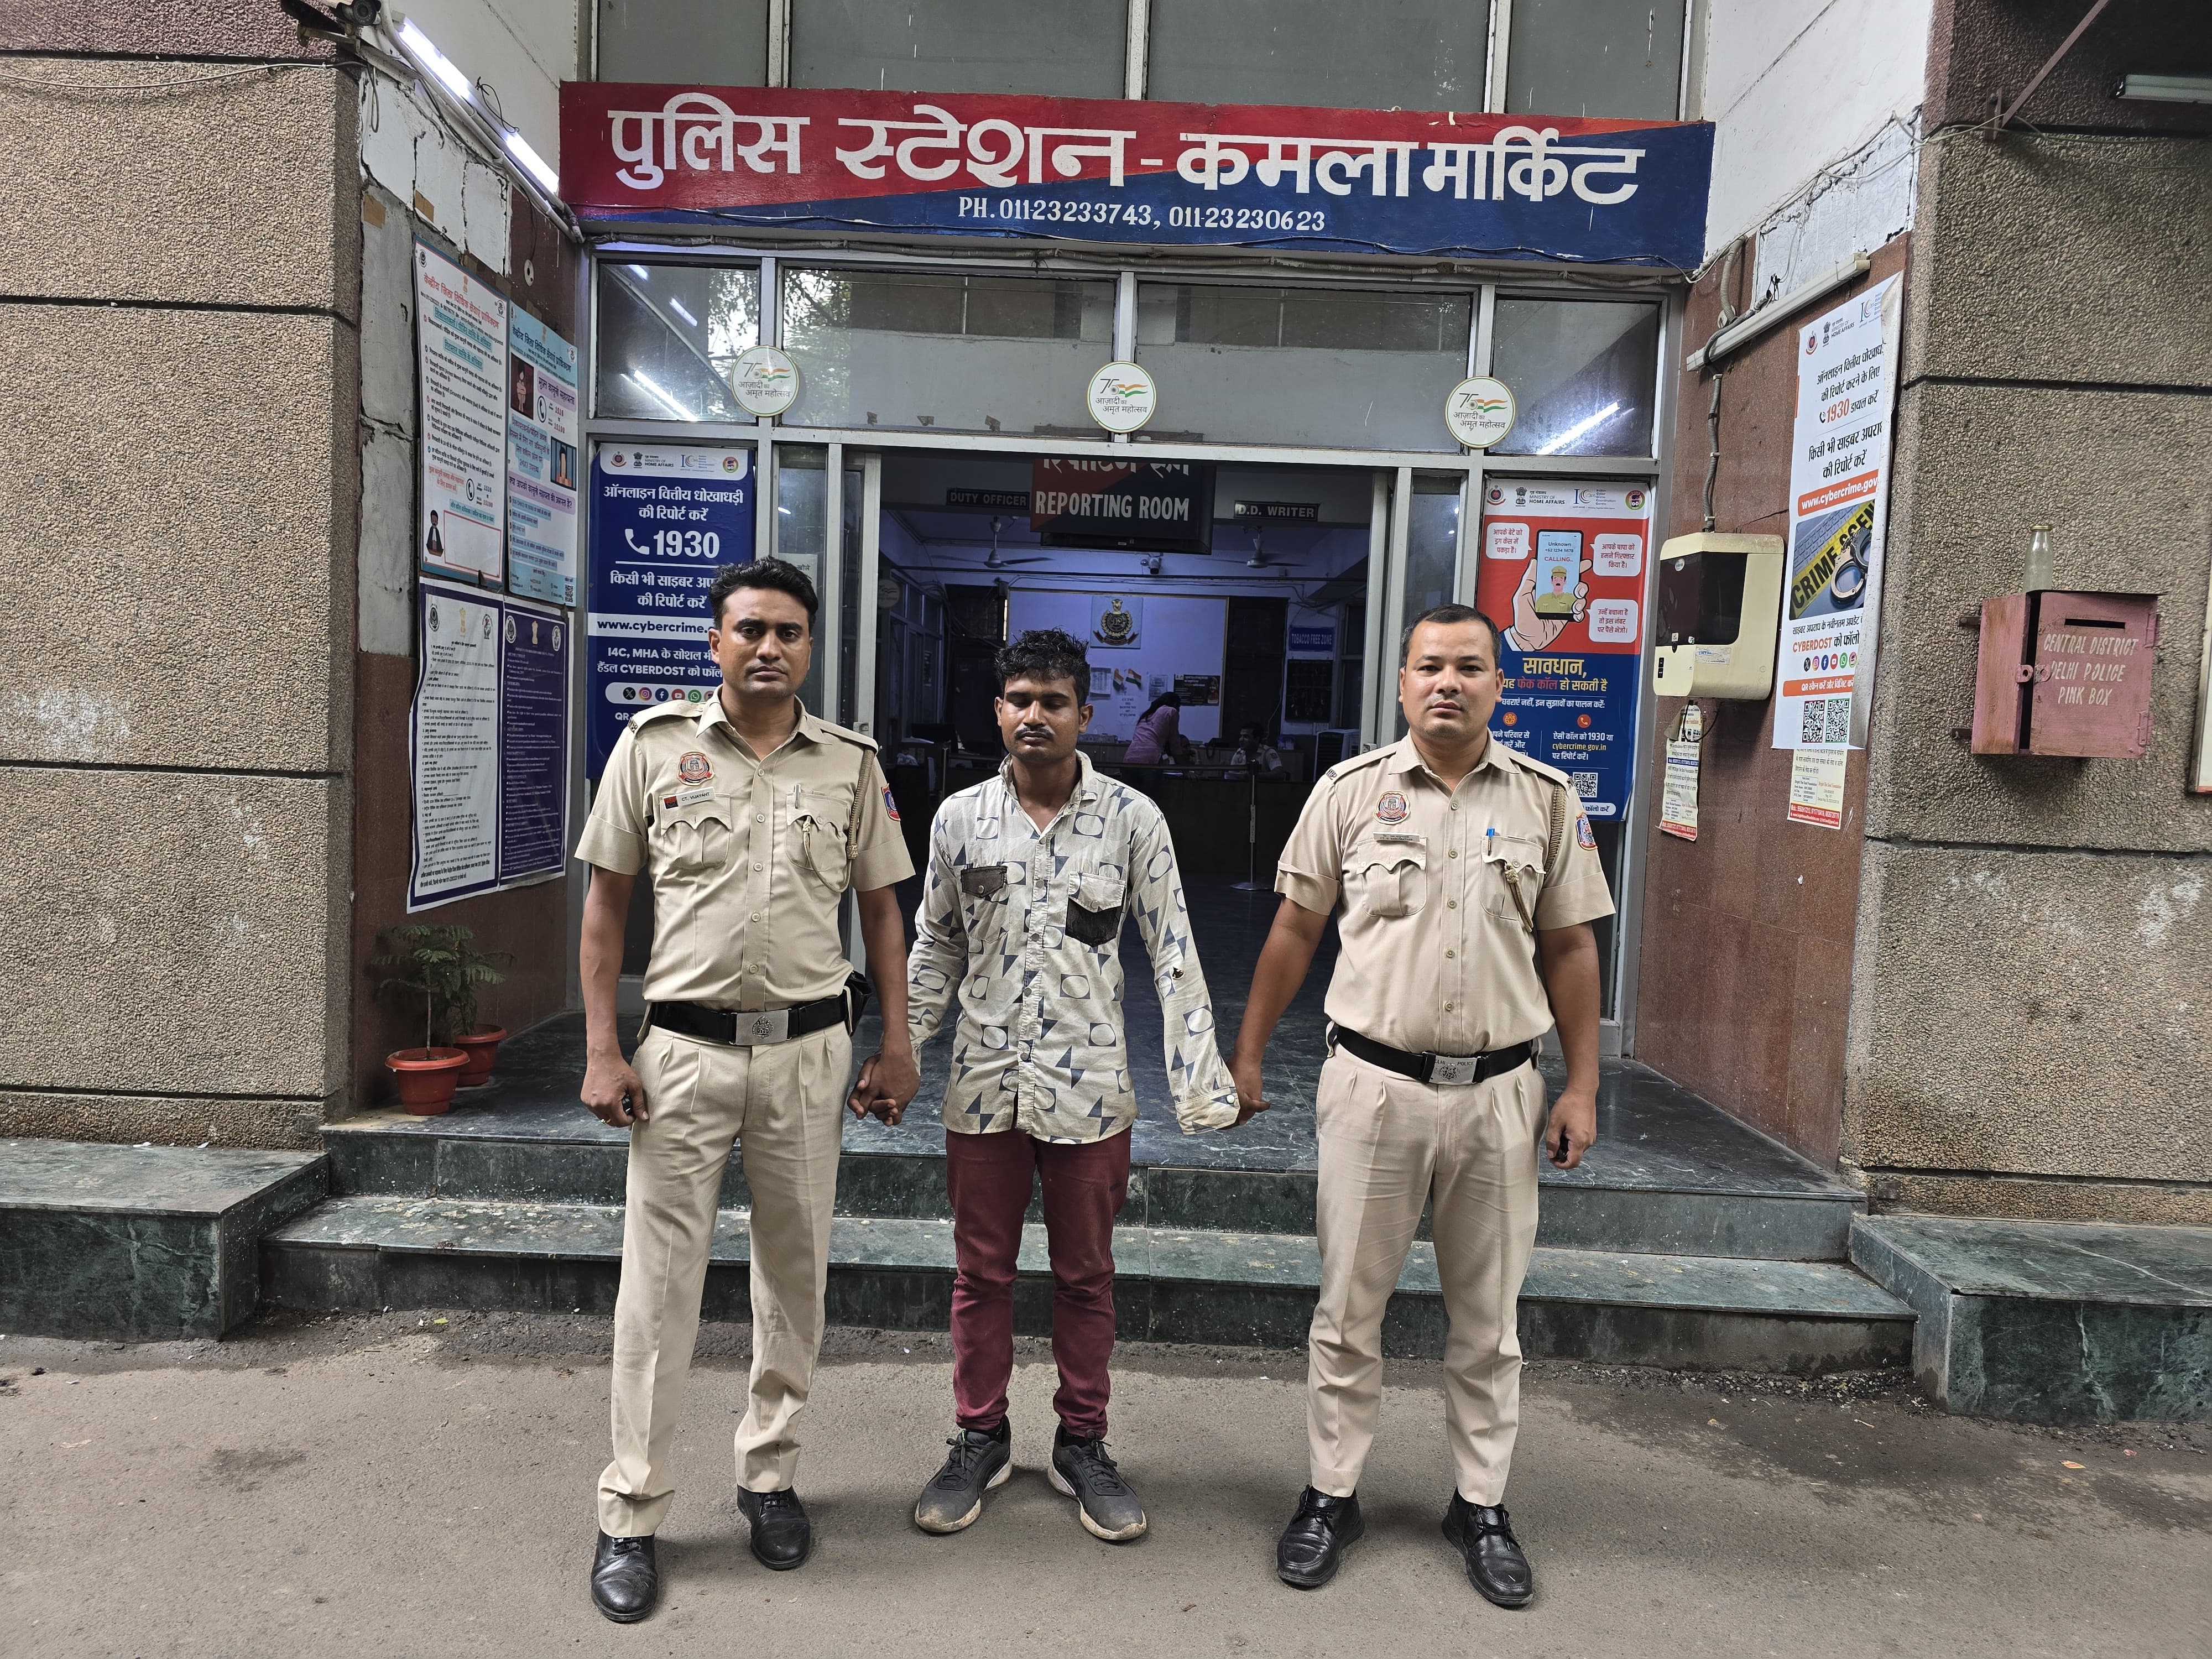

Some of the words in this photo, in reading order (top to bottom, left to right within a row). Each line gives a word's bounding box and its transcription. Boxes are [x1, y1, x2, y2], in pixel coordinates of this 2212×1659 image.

[607, 92, 810, 190] पुलिस
[836, 105, 1136, 188] स्टेशन
[1176, 132, 1418, 197] कमला
[1423, 126, 1646, 205] मार्किट
[958, 196, 995, 218] PH.
[1170, 206, 1326, 231] 011-23230623
[1831, 329, 1841, 338] HOME
[1817, 364, 1843, 385] ऑनलाइन
[1844, 354, 1861, 372] वित्तीय
[745, 390, 763, 399] अमृत
[765, 388, 792, 398] महोत्सव
[1821, 388, 1829, 405] की
[1830, 379, 1845, 399] रिपोर्ट
[1846, 373, 1860, 390] करने
[1861, 371, 1868, 383] के
[1869, 366, 1880, 380] लिए
[1103, 405, 1120, 415] अमृत
[1121, 404, 1147, 414] महोत्सव
[1827, 398, 1850, 423] 1930
[1850, 397, 1866, 413] डायल
[1867, 389, 1879, 405] करें
[1460, 420, 1478, 430] अमृत
[1479, 419, 1506, 429] महोत्सव
[1808, 441, 1825, 462] किसी
[1827, 437, 1835, 453] भी
[1837, 431, 1860, 450] साइबर
[1823, 461, 1833, 478] की
[1834, 453, 1853, 476] रिपोर्ट
[1854, 449, 1867, 468] करें
[603, 484, 656, 500] ऑनलाइन
[658, 486, 691, 501] वित्तीय
[694, 488, 743, 505] धोखाधड़ी
[951, 492, 978, 503] DUTY
[983, 494, 1027, 507] OFFICER
[639, 504, 654, 519] की
[656, 505, 686, 520] रिपोर्ट
[688, 508, 709, 521] करें
[1035, 491, 1133, 518] REPORTING
[1138, 495, 1190, 521] ROOM
[1267, 506, 1314, 518] WRITER
[653, 530, 719, 559] 1930
[610, 570, 639, 585] किसी
[641, 571, 655, 586] भी
[657, 576, 693, 588] साइबर
[1791, 544, 1838, 609] CRIME
[637, 592, 653, 607] की
[655, 592, 685, 608] रिपोर्ट
[687, 595, 707, 608] करें
[1792, 625, 1806, 635] साइबर
[1807, 623, 1821, 633] अपराध
[1821, 620, 1826, 630] के
[1827, 618, 1845, 630] नवीनतम
[1845, 614, 1860, 627] अपडेट
[1291, 633, 1310, 645] TOBACCO
[1310, 634, 1321, 645] FREE
[1321, 634, 1332, 645] ZONE
[1792, 637, 1833, 653] CYBERDOST
[1834, 633, 1843, 647] को
[1843, 629, 1860, 646] फॉलो
[2043, 633, 2086, 655] CENTRAL
[2089, 636, 2140, 658] DISTRICT
[633, 648, 659, 659] MHA
[661, 647, 671, 659] के
[672, 648, 701, 661] सोशल
[597, 661, 618, 673] हैंडल
[620, 664, 685, 676] CYBERDOST
[687, 665, 700, 677] को
[1522, 657, 1588, 679] सावधान,
[2052, 660, 2079, 680] DELHI
[2083, 662, 2126, 682] POLICE
[1503, 679, 1516, 688] यह
[1517, 678, 1535, 689] फेक
[1537, 677, 1558, 690] कॉल
[1559, 677, 1571, 691] हो
[1571, 678, 1599, 691] सकती
[1600, 678, 1608, 692] है
[1801, 683, 1809, 691] QR
[1826, 679, 1834, 689] और
[1546, 698, 1566, 709] सुझावों
[2058, 686, 2085, 706] PINK
[2088, 687, 2114, 706] BOX
[1504, 730, 1523, 738] परिवार
[1524, 730, 1530, 739] से
[1553, 731, 1565, 740] ऐसी
[1565, 731, 1579, 740] कॉल
[1579, 732, 1588, 740] को
[1588, 732, 1605, 741] 1930
[1514, 740, 1526, 748] और
[1552, 742, 1606, 752] cybercrime.gov.in
[1561, 751, 1577, 760] रिपोर्ट
[690, 791, 710, 800] VIJAYANT
[1585, 804, 1599, 812] फॉलो
[1599, 805, 1610, 813] करें
